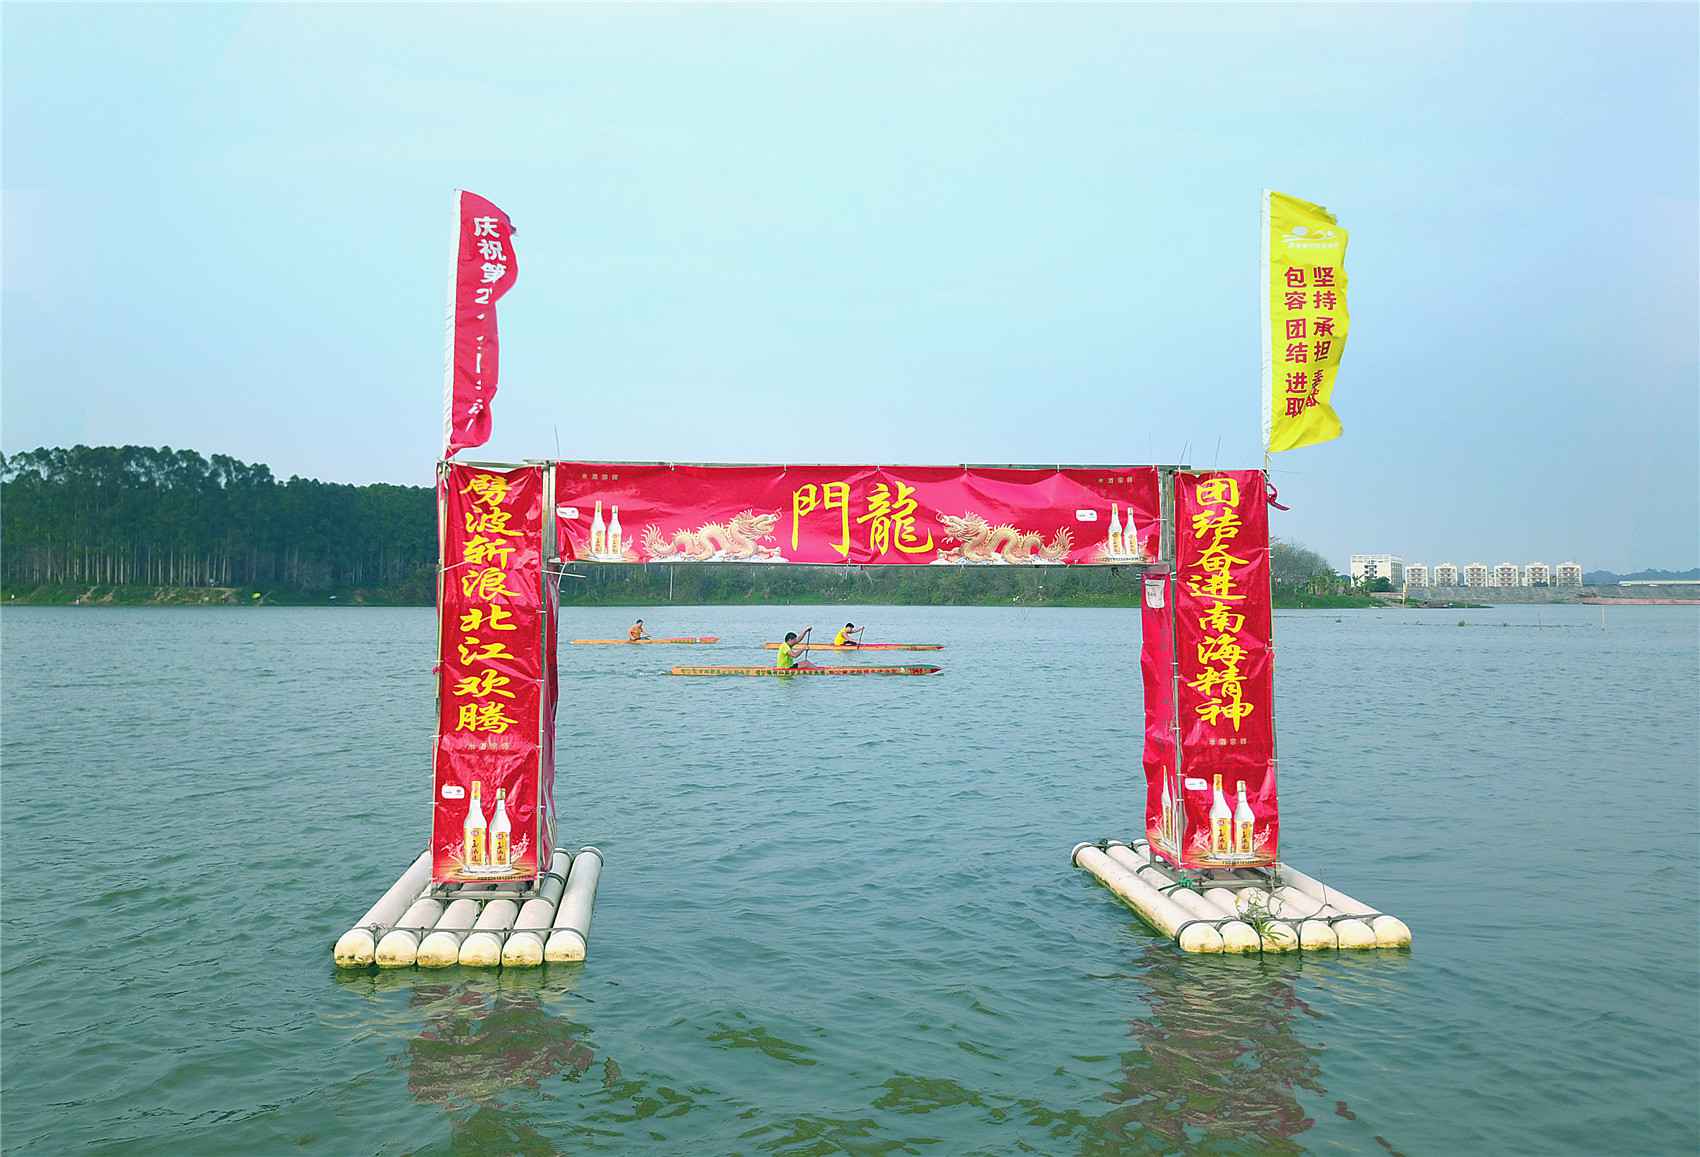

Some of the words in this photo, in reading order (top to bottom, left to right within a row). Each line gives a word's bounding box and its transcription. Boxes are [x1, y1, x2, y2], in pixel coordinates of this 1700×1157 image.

[1284, 266, 1308, 418] 包容团结进取
[1186, 477, 1255, 733] 团结奋进南海精神
